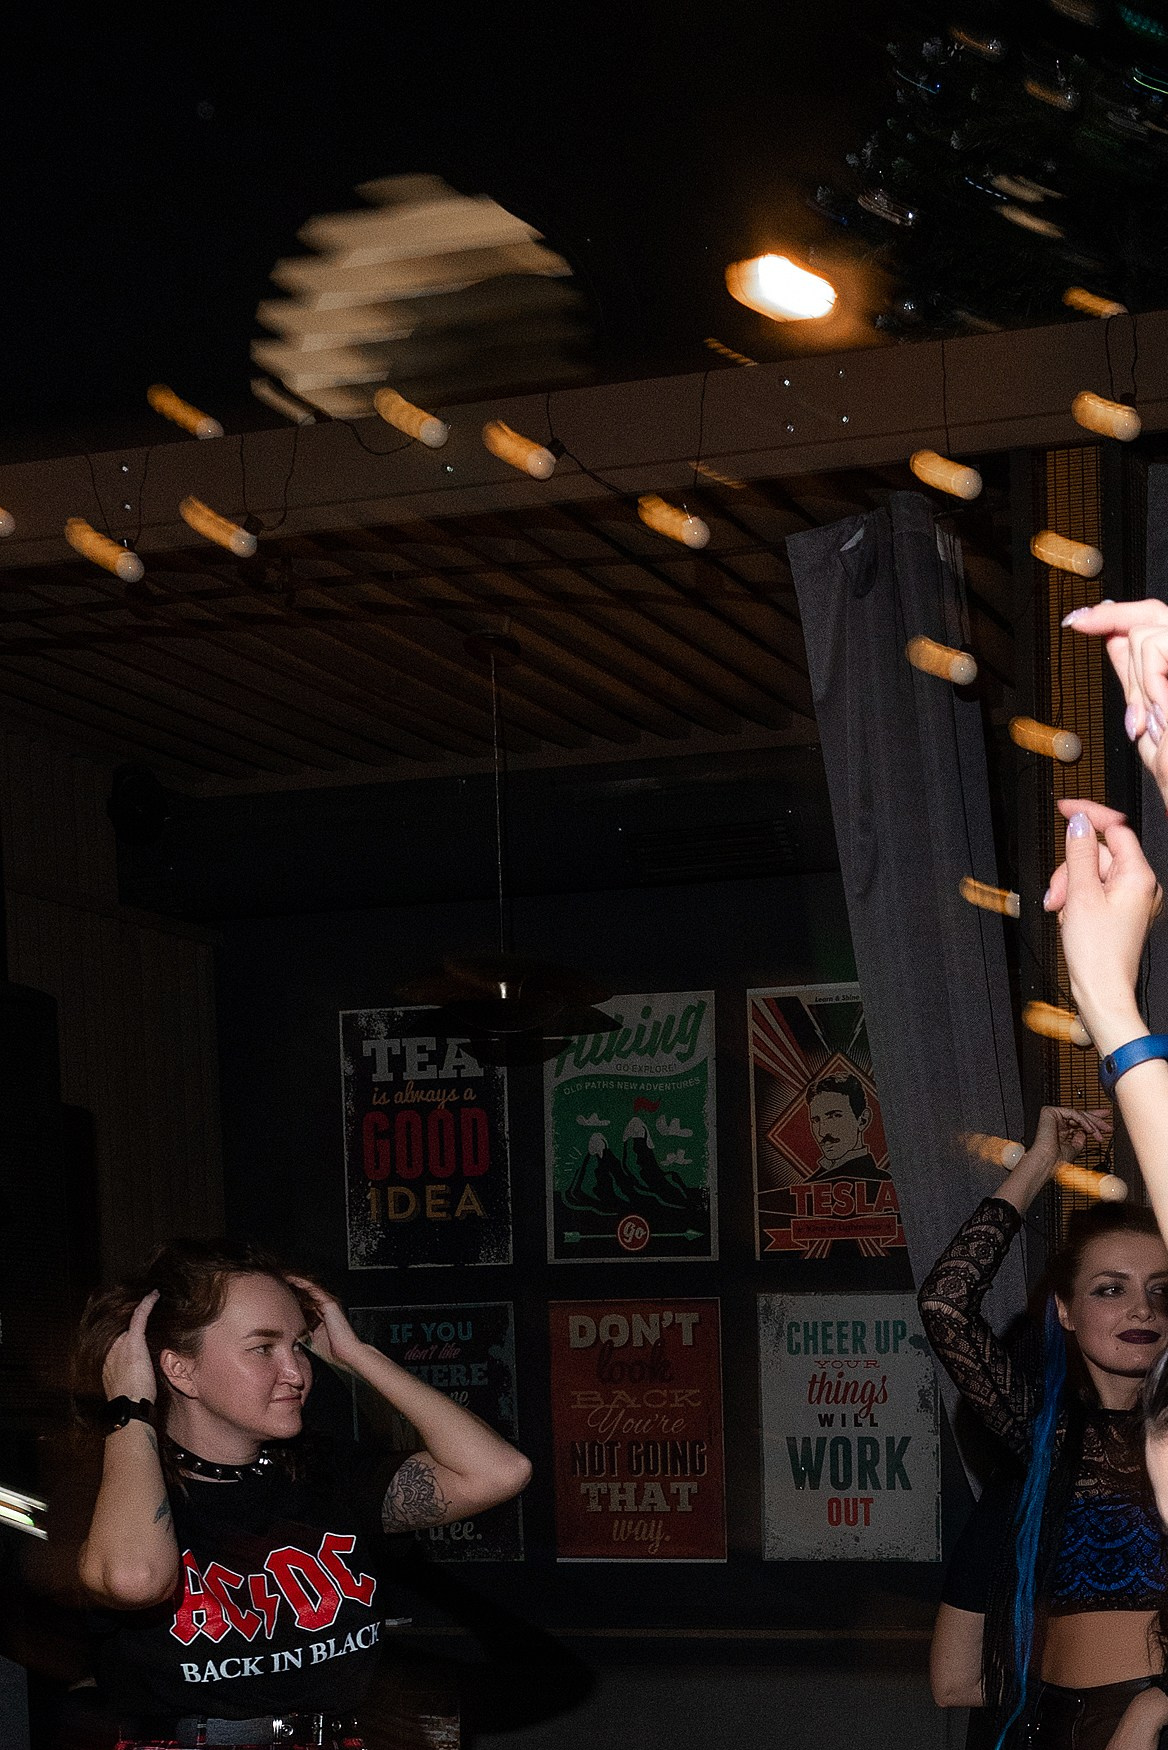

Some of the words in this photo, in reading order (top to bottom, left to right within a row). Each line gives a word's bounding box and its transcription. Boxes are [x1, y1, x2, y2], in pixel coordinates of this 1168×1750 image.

[362, 1036, 485, 1082] TEA
[615, 1063, 629, 1072] GO
[370, 1086, 391, 1106] is
[393, 1080, 461, 1111] always
[463, 1086, 478, 1102] a
[563, 1082, 583, 1096] OLD
[584, 1080, 615, 1091] PATHS
[616, 1081, 638, 1092] NEW
[639, 1076, 702, 1092] ADVENTURES
[361, 1107, 492, 1181] GOOD
[369, 1183, 489, 1223] IDEA
[790, 1181, 900, 1217] TESLA
[389, 1323, 415, 1344] IF
[420, 1320, 473, 1343] YOU
[786, 1321, 866, 1356] CHEER
[874, 1319, 907, 1354] UP
[598, 1337, 673, 1384] look
[814, 1359, 880, 1369] YOUR
[570, 1388, 702, 1409] BACK
[808, 1371, 888, 1419] things
[818, 1412, 879, 1428] WILL
[571, 1440, 622, 1477] NOT
[627, 1439, 708, 1477] GOING
[785, 1436, 912, 1490] WORK
[580, 1482, 698, 1512] THAT
[827, 1497, 874, 1527] OUT
[611, 1518, 671, 1555] way.
[180, 1656, 264, 1683] BACK
[270, 1648, 303, 1674] IN
[309, 1621, 381, 1665] BLACK
